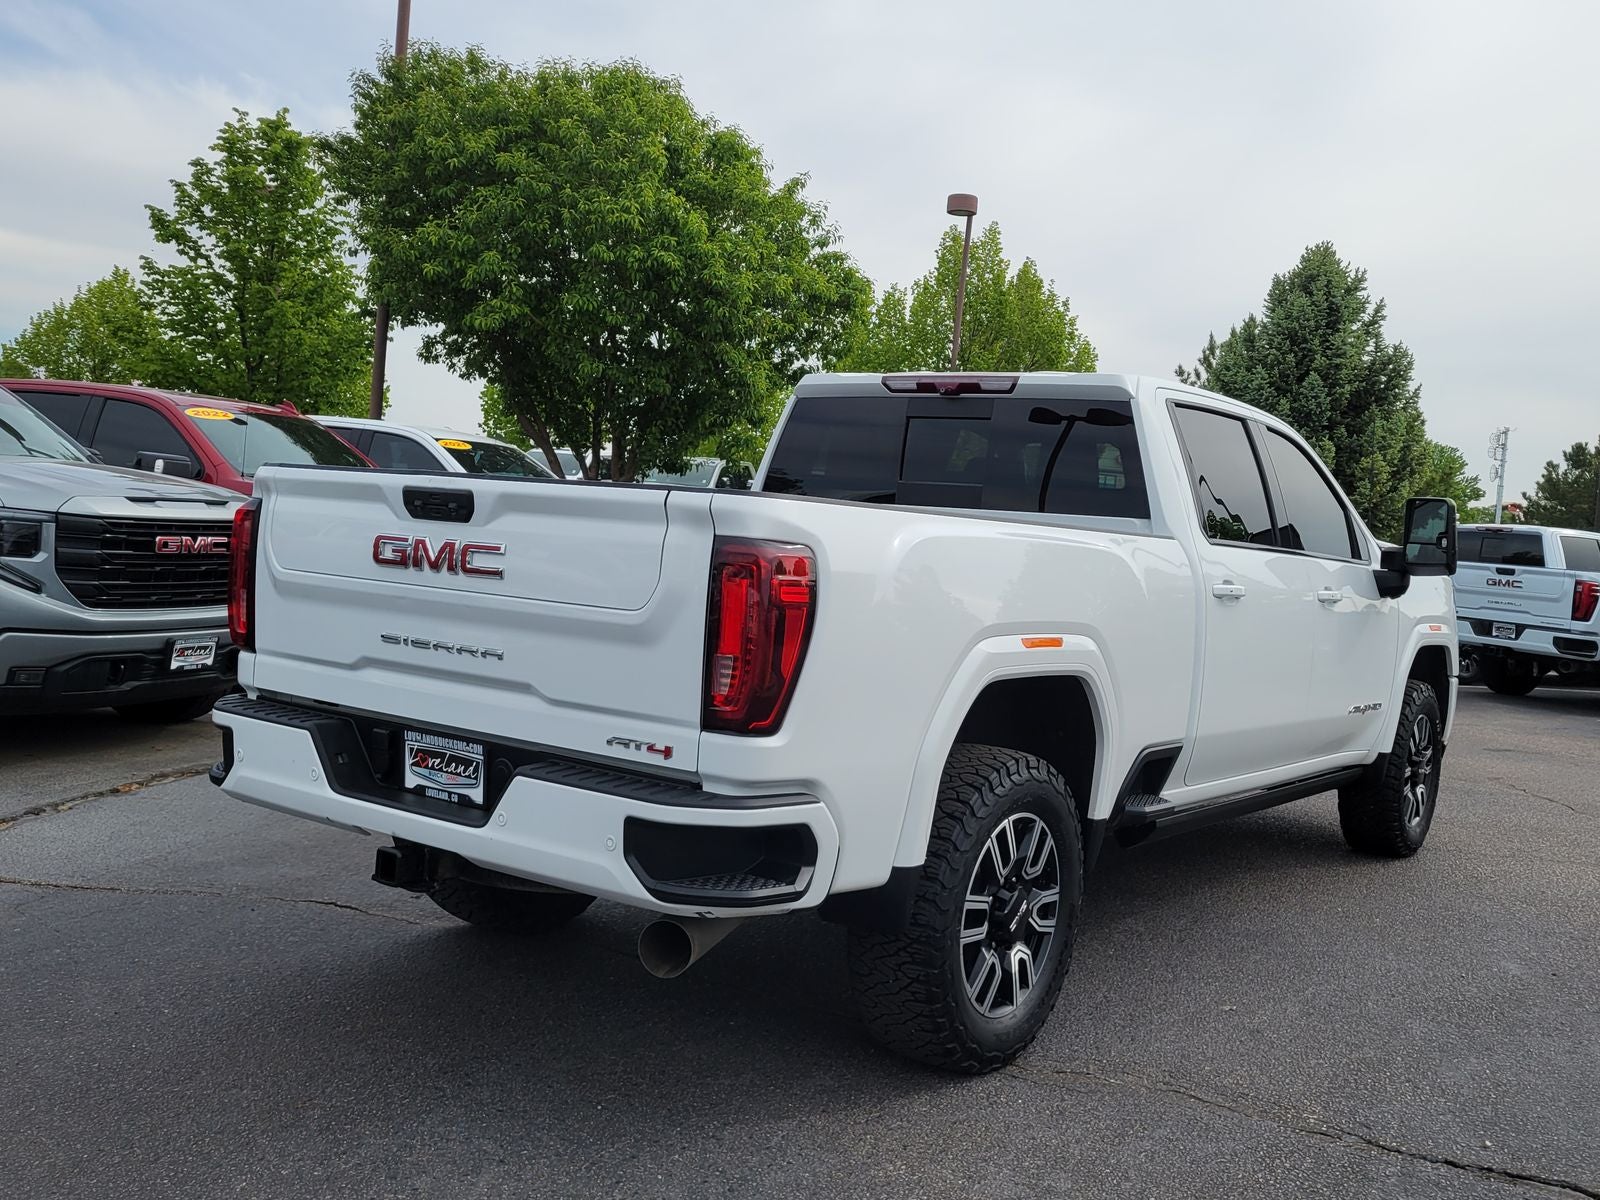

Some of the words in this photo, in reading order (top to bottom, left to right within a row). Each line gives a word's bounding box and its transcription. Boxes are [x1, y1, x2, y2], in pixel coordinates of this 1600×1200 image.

[155, 535, 230, 554] GMC
[373, 533, 505, 580] GMC
[1486, 578, 1523, 589] GMC
[380, 632, 504, 661] SIERRA
[606, 736, 674, 761] AT4
